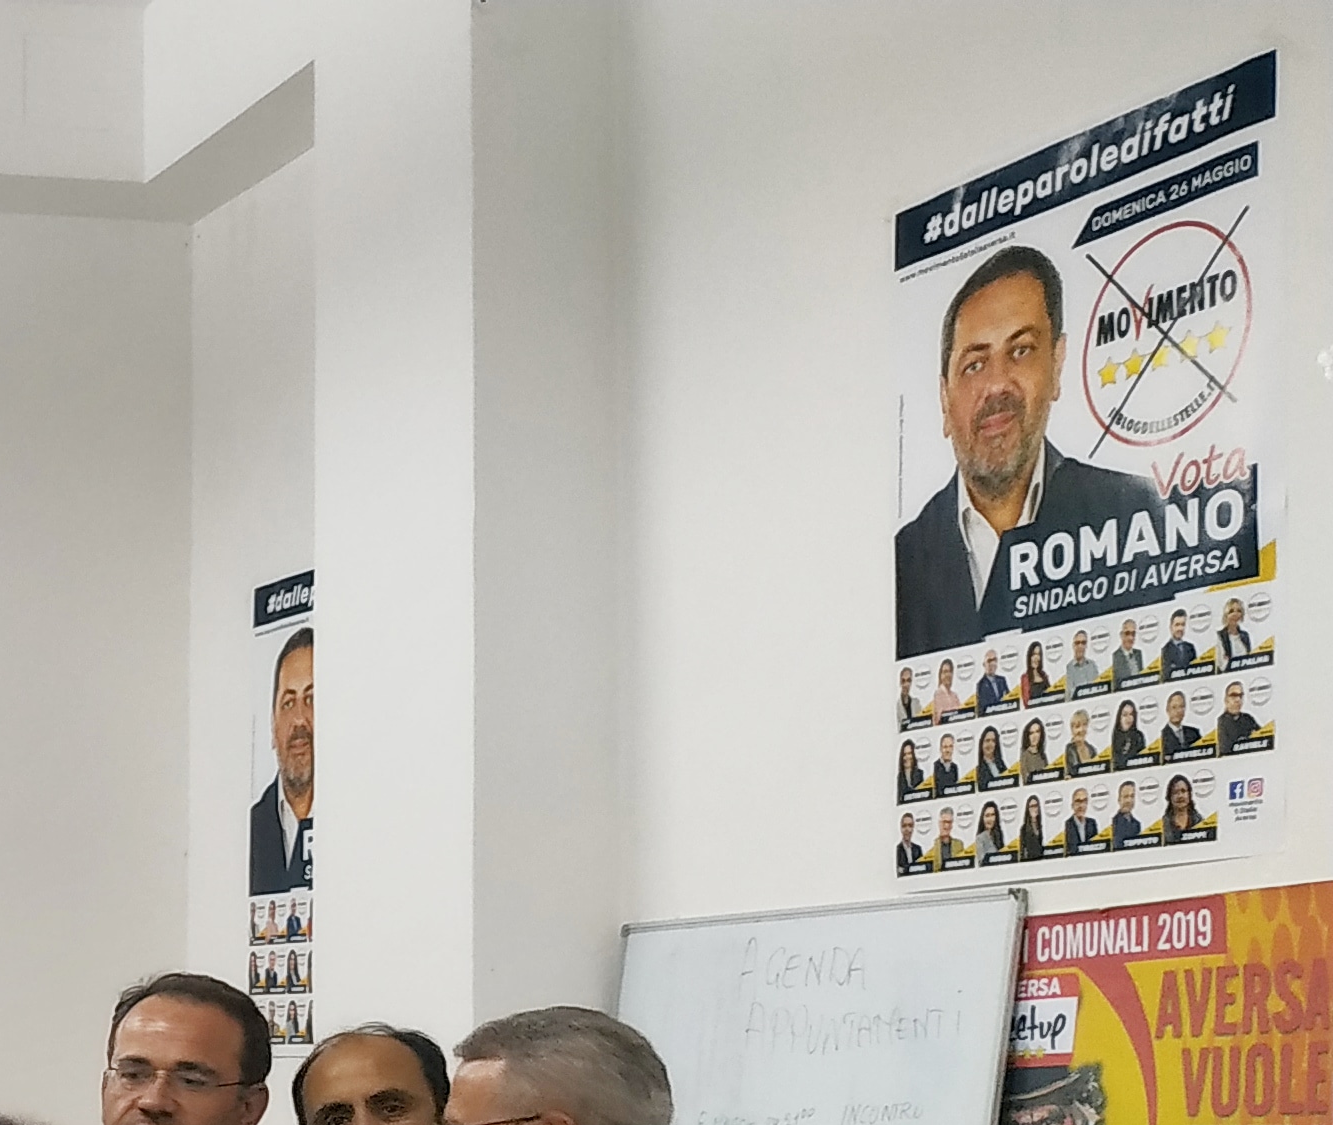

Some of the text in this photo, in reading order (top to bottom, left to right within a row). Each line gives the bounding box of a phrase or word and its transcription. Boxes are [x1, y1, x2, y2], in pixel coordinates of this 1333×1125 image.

[1091, 154, 1254, 232] DOMENICA 26 MAGGIO
[1095, 269, 1239, 347] MOVIMENTO
[1150, 444, 1248, 499] Vota
[1008, 488, 1245, 591] ROMANO
[1013, 545, 1240, 619] SINDACO DI AVERSA
[738, 937, 868, 997] AGENDA
[1036, 908, 1213, 963] COMUNALI 2019
[1017, 976, 1062, 998] ERSA
[1154, 956, 1330, 1042] AVERSA
[1015, 1004, 1067, 1050] etup
[1180, 1038, 1330, 1119] VUOLE
